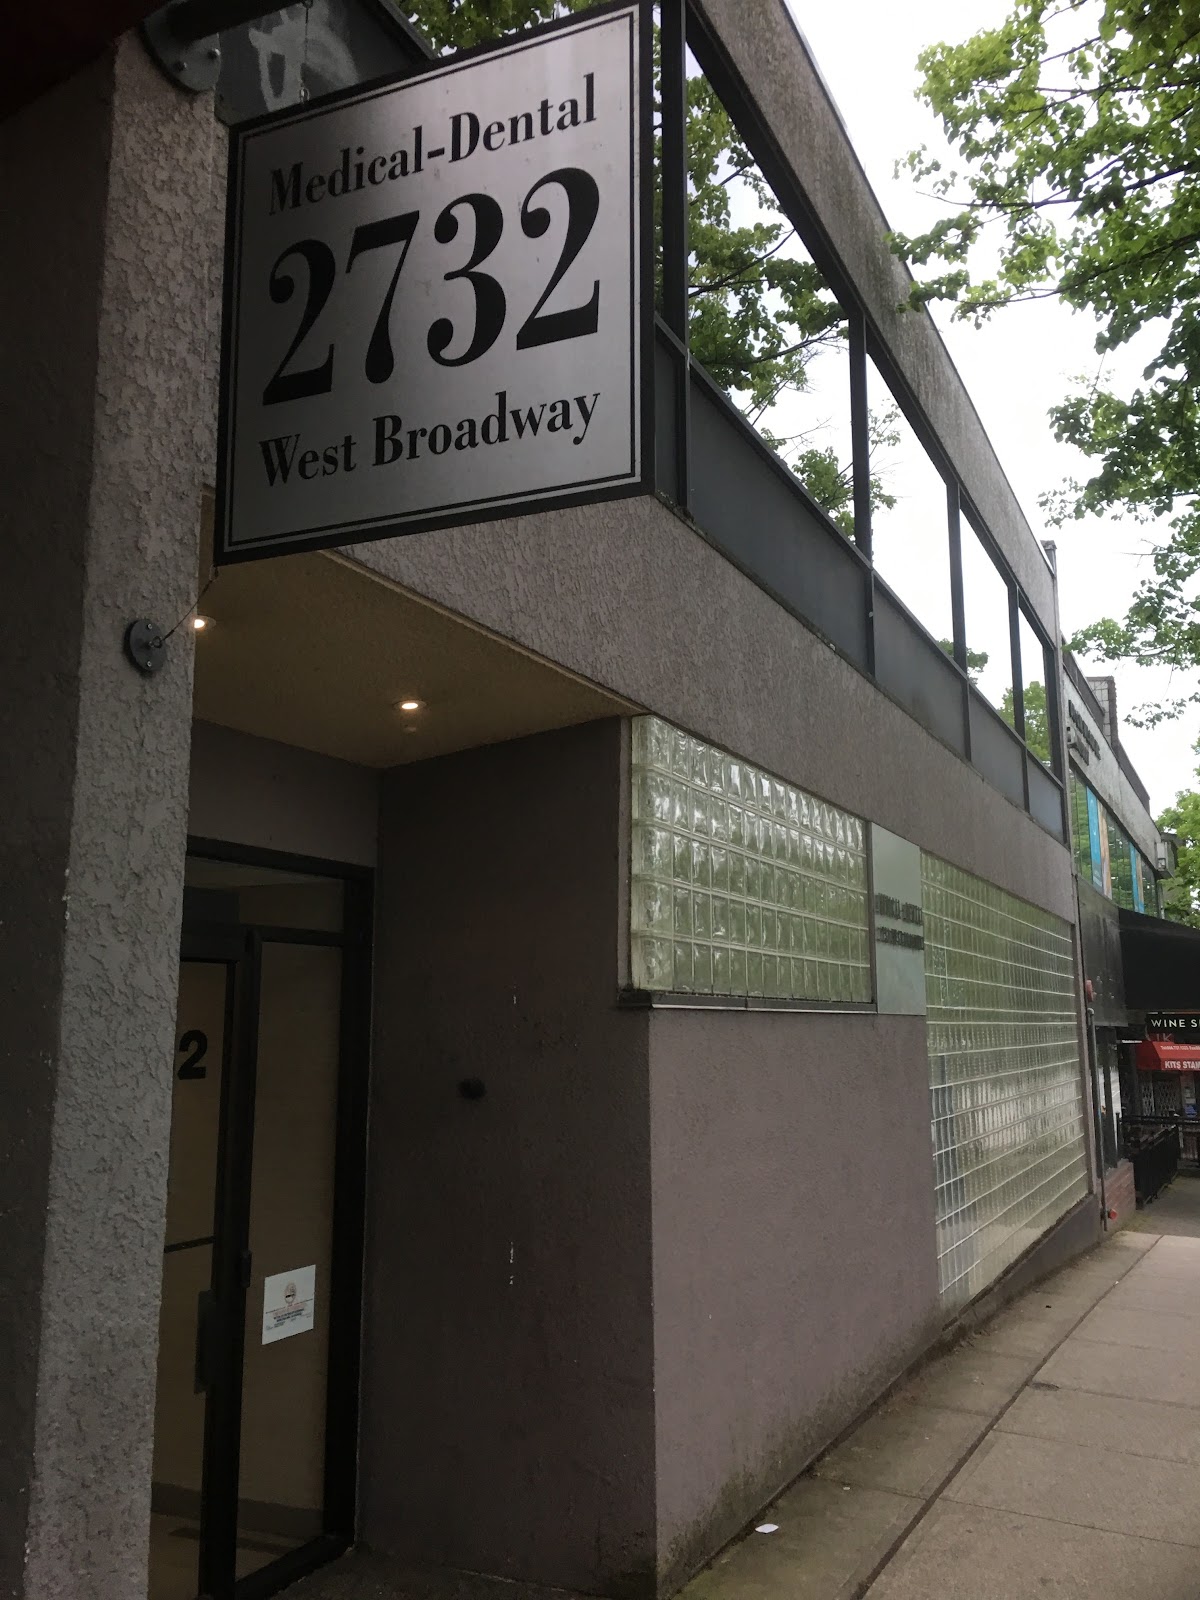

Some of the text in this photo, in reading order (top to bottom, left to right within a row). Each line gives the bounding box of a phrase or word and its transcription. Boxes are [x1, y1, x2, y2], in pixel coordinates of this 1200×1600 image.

[269, 72, 598, 216] Medical-Dental
[262, 167, 600, 406] 2732
[259, 390, 601, 488] West Broadway
[178, 1029, 208, 1080] 2
[1151, 1019, 1186, 1028] WINE
